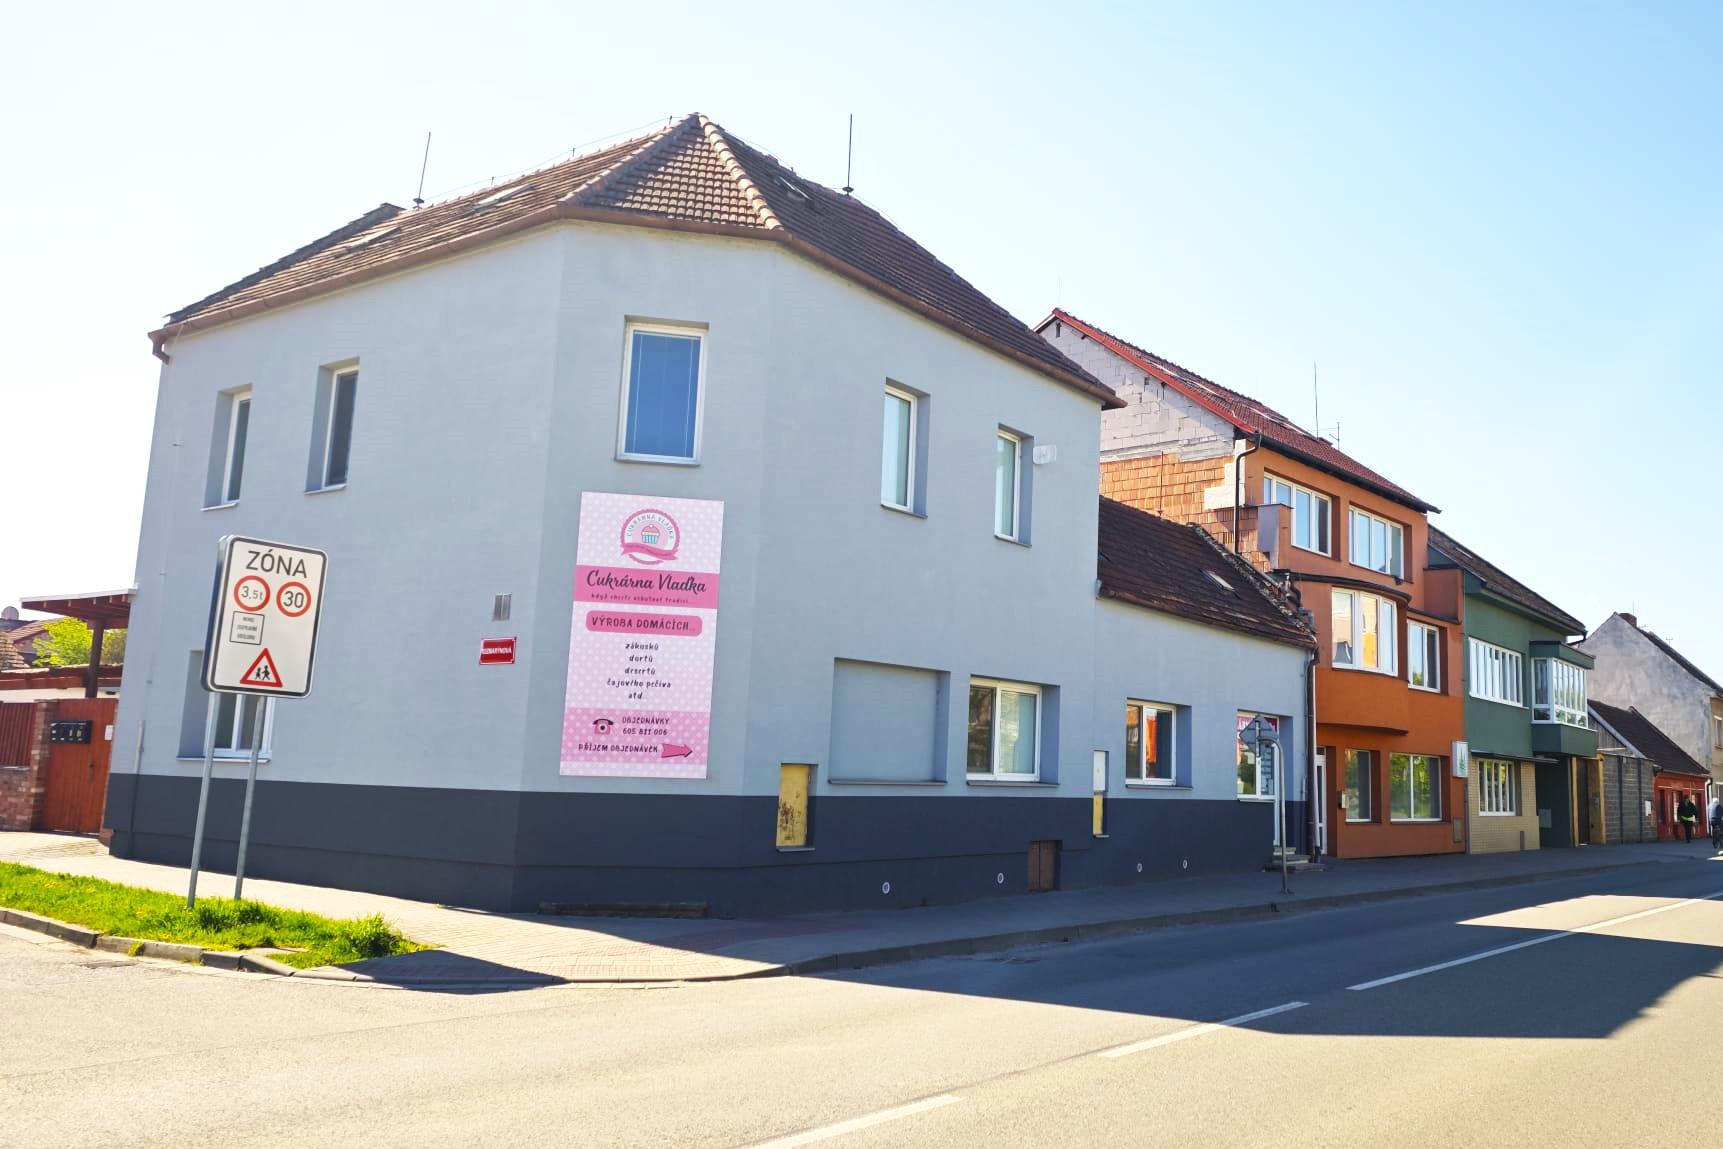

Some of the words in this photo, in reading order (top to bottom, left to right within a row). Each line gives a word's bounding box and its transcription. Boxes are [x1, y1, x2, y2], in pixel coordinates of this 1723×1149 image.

[246, 548, 307, 578] ZÓNA
[586, 569, 654, 590] Cukrárna
[283, 590, 305, 609] 30
[592, 615, 633, 628] VÝROBA
[622, 716, 670, 725] OBJEDNÁVKY
[578, 743, 609, 752] PŘÍJEM
[610, 744, 658, 753] OBJEDNÁVEK
